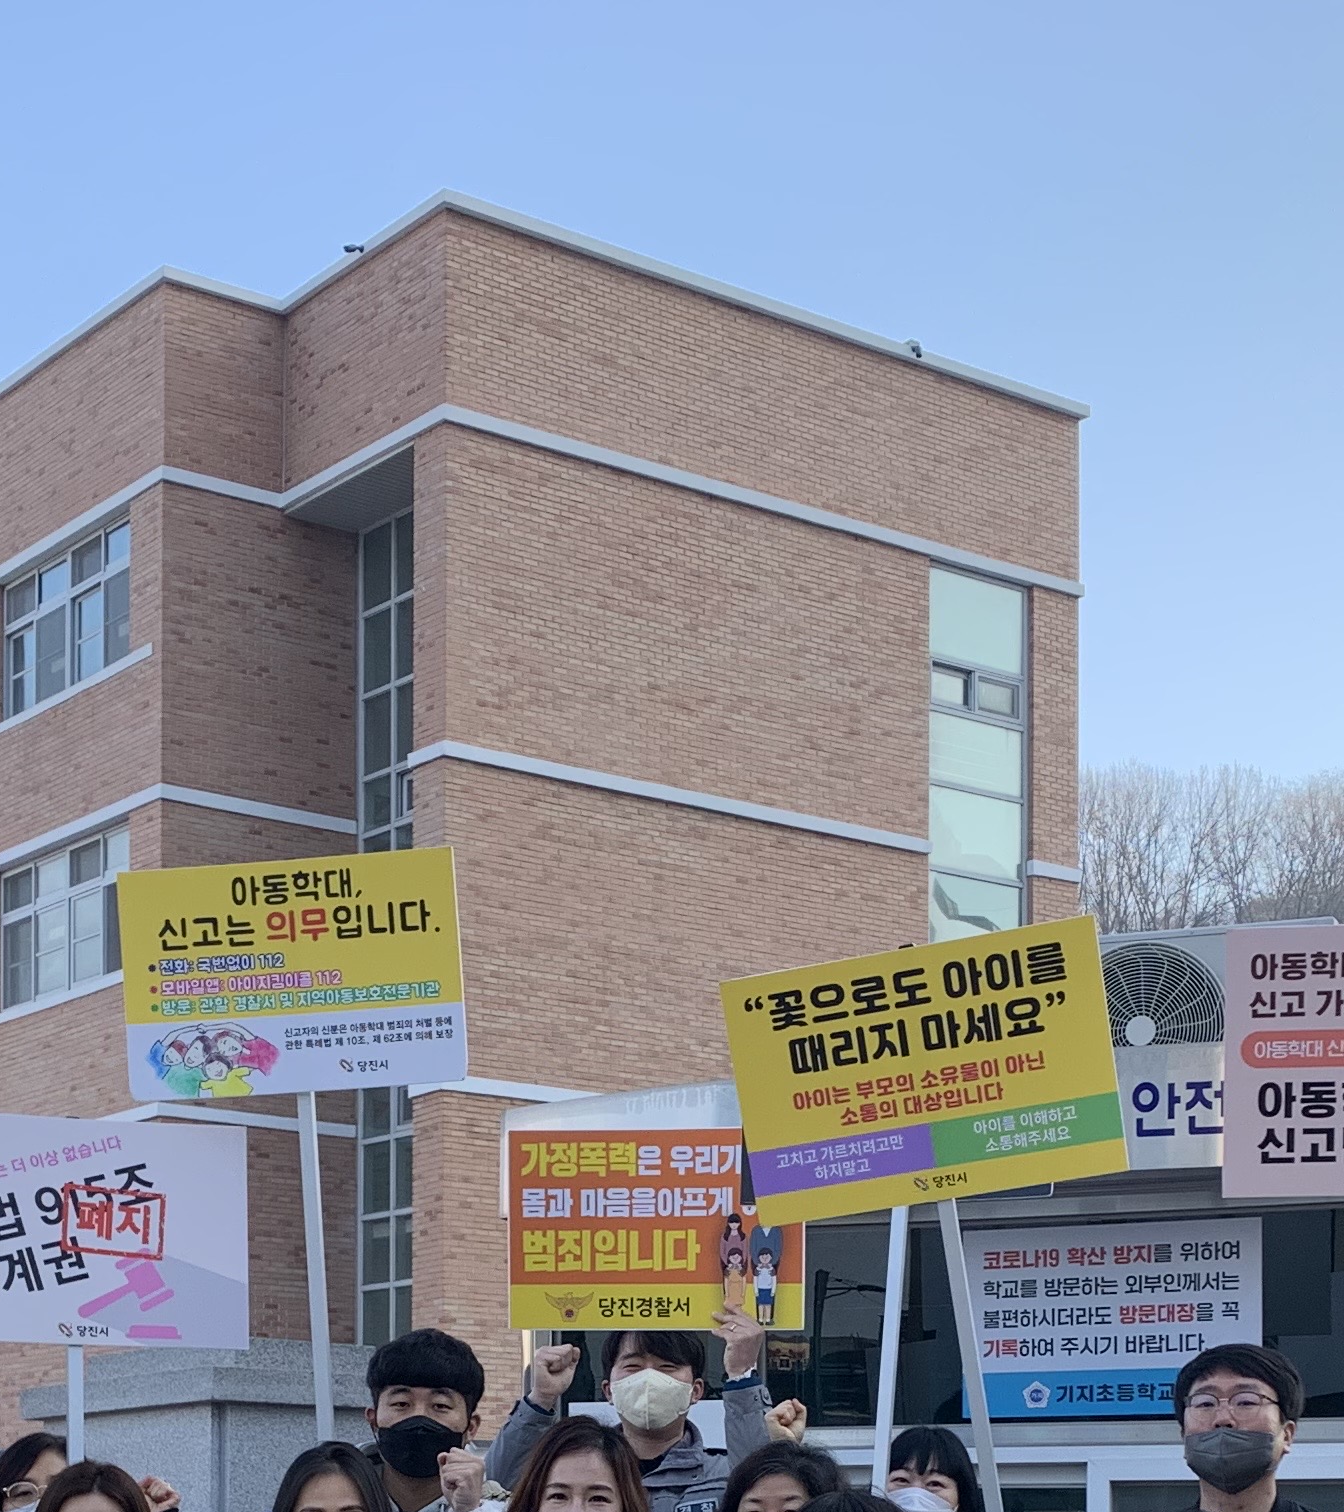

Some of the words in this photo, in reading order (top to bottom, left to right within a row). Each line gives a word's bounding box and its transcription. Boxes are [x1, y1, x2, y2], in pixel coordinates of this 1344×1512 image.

[231, 867, 362, 906] 아동학대,
[158, 915, 255, 951] 신고는
[266, 899, 440, 942] 의무입니다.
[159, 958, 194, 976] 전화:
[197, 955, 255, 972] 국번없이
[258, 953, 284, 968] 112
[942, 941, 1068, 999] 아이를
[160, 978, 224, 996] 모바일앱:
[229, 974, 313, 992] 아이지킴이콜
[316, 970, 342, 985] 112
[199, 997, 229, 1013] 관할
[233, 994, 276, 1011] 경찰서
[280, 992, 296, 1008] 및
[298, 980, 440, 1007] 지역아동보호전문기관
[1250, 988, 1306, 1019] 신고
[284, 1026, 320, 1038] 신고자의
[321, 1024, 348, 1036] 신분은
[789, 1019, 911, 1075] 때리지
[1254, 1038, 1323, 1060] 아동학대
[357, 1059, 389, 1072] 당진시
[794, 1084, 851, 1112] 아이는
[856, 1072, 915, 1101] 부모의
[919, 1057, 1001, 1092] 소유물이
[1006, 1050, 1046, 1076] 아닌
[840, 1099, 897, 1127] 소통의
[904, 1082, 1004, 1117] 대상입니다
[973, 1114, 1016, 1136] 아이를
[1020, 1105, 1077, 1128] 이해하고
[985, 1125, 1072, 1153] 소통해주세요
[12, 1156, 26, 1174] 더
[30, 1150, 59, 1171] 이상
[62, 1135, 122, 1164] 없습니다
[520, 1141, 661, 1178] 가정폭력은
[776, 1148, 819, 1170] 고치고
[814, 1158, 871, 1181] 하지말고
[932, 1171, 968, 1188] 당진시
[522, 1188, 573, 1218] 몸과
[74, 1194, 153, 1247] 폐지
[522, 1229, 701, 1272] 범죄입니다
[983, 1248, 1060, 1270] 코로나19
[1066, 1246, 1106, 1267] 확산
[1113, 1243, 1172, 1265] 방지를
[1179, 1240, 1241, 1262] 위하여
[983, 1279, 1037, 1300] 학교를
[1043, 1276, 1119, 1297] 방문하는
[1124, 1271, 1241, 1295] 외부인께서는
[598, 1297, 690, 1318] 당진경찰서
[983, 1305, 1113, 1329] 불편하시더라도
[1119, 1303, 1214, 1325] 방문대장을
[1221, 1301, 1240, 1322] 꼭
[76, 1323, 110, 1339] 당진시
[983, 1337, 1054, 1359] 기록하여
[1060, 1335, 1119, 1357] 주시기
[1125, 1332, 1206, 1356] 바랍니다.
